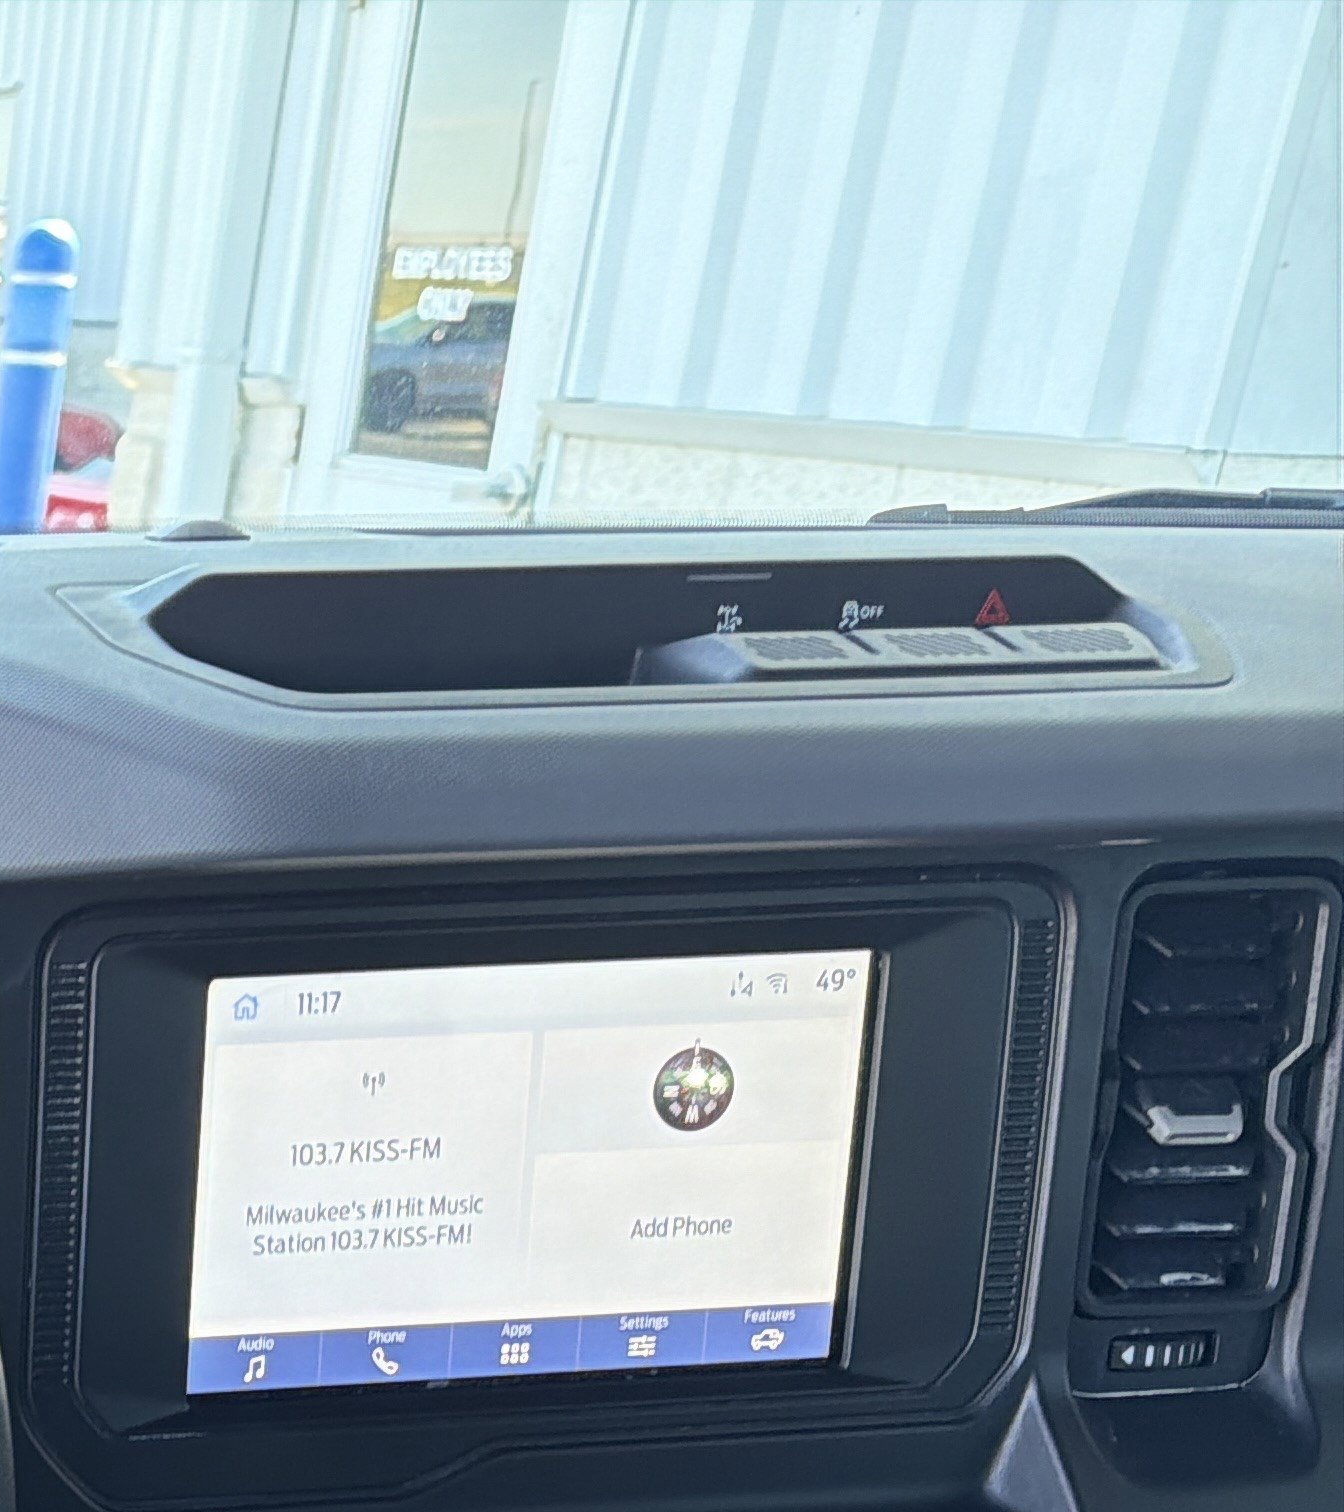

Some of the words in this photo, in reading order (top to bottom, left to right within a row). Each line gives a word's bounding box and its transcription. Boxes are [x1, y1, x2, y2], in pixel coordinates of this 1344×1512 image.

[861, 605, 884, 620] OFF
[298, 991, 342, 1016] 11:17
[291, 1143, 344, 1167] 103.7
[350, 1137, 441, 1163] KISS-FM
[246, 1201, 366, 1227] Milwaukee's
[371, 1199, 391, 1219] #1
[396, 1197, 424, 1218] Hit
[430, 1194, 484, 1216] Music
[630, 1219, 668, 1239] Add
[672, 1216, 732, 1236] Phone
[253, 1232, 326, 1257] Station
[331, 1228, 378, 1251] 103.7
[383, 1223, 472, 1248] KISS-FM!
[619, 1313, 670, 1333] Settings
[744, 1307, 796, 1324] Features
[368, 1329, 406, 1346] Phone
[502, 1323, 533, 1338] Apps
[237, 1335, 275, 1353] Audio
